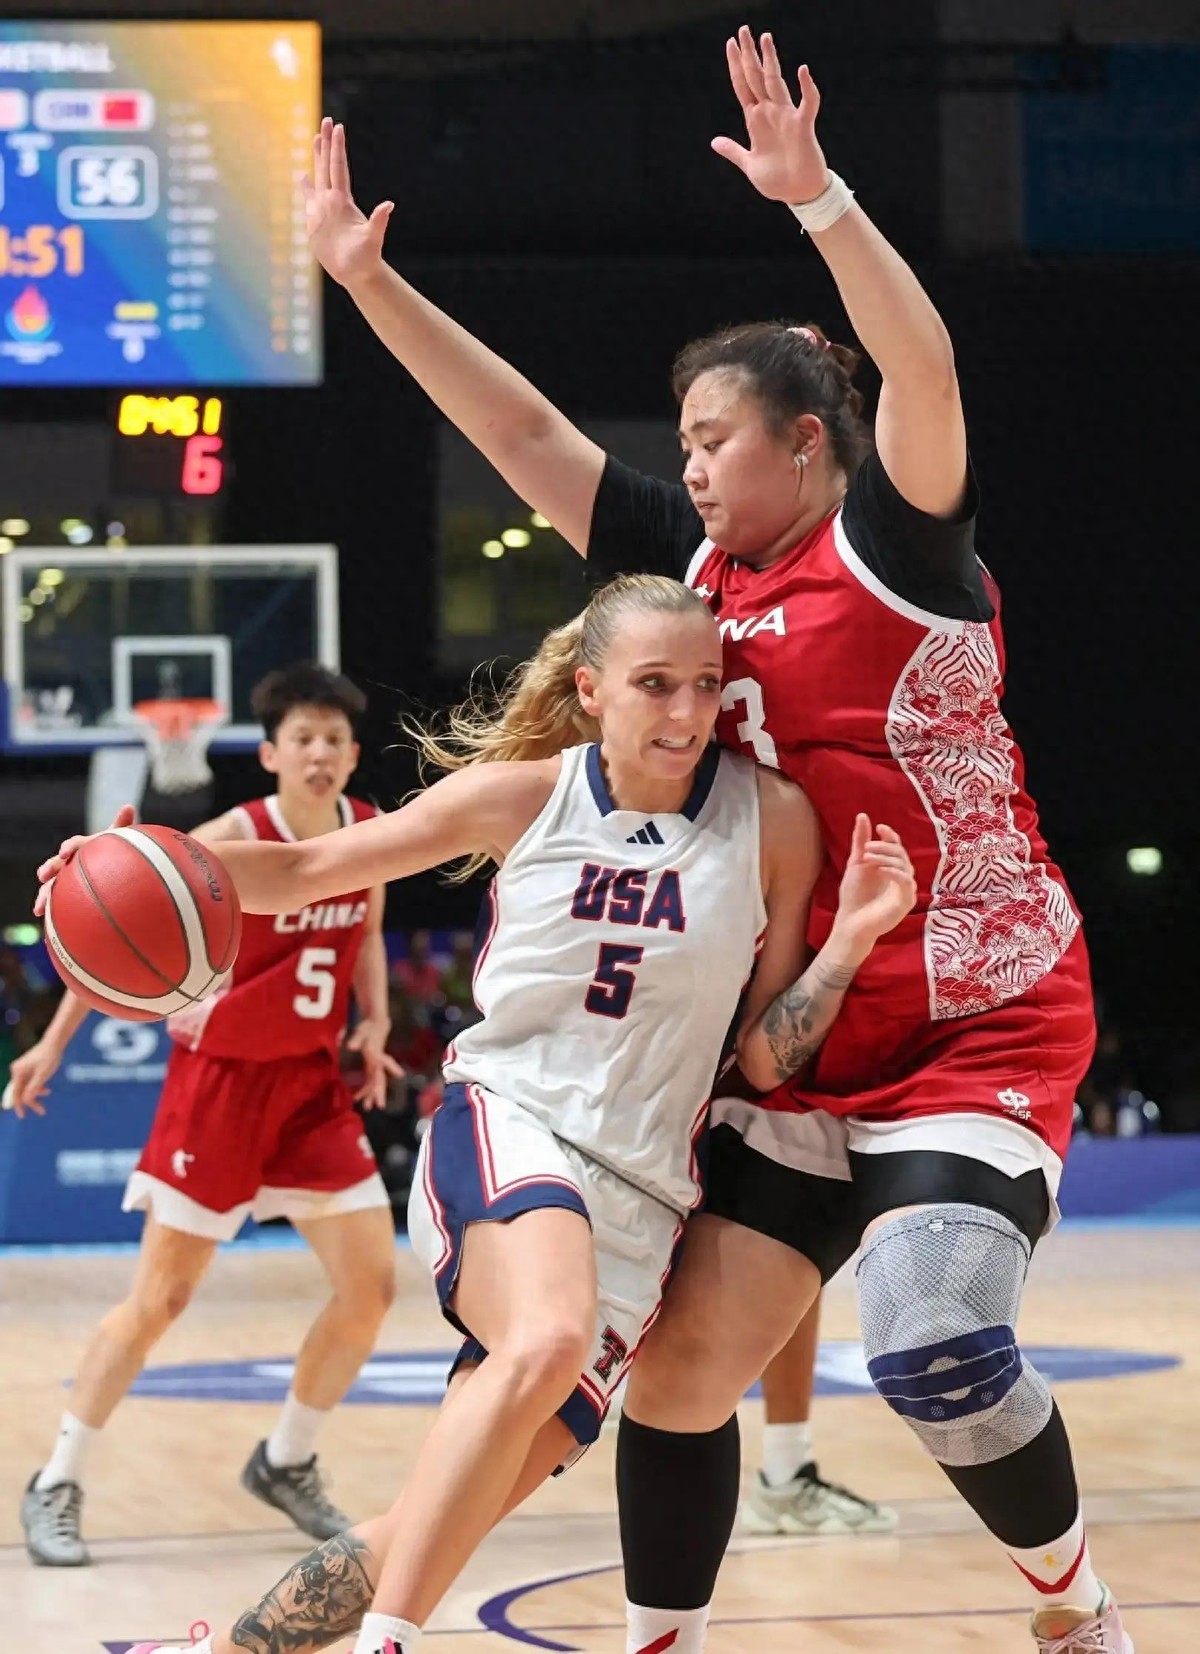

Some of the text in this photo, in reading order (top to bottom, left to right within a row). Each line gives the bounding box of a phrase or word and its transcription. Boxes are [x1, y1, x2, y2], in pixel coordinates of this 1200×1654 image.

[75, 157, 141, 207] 56
[182, 435, 224, 495] 6
[273, 901, 368, 934] CHINA
[570, 862, 686, 933] USA
[292, 946, 338, 1020] 5
[584, 942, 645, 1020] 5
